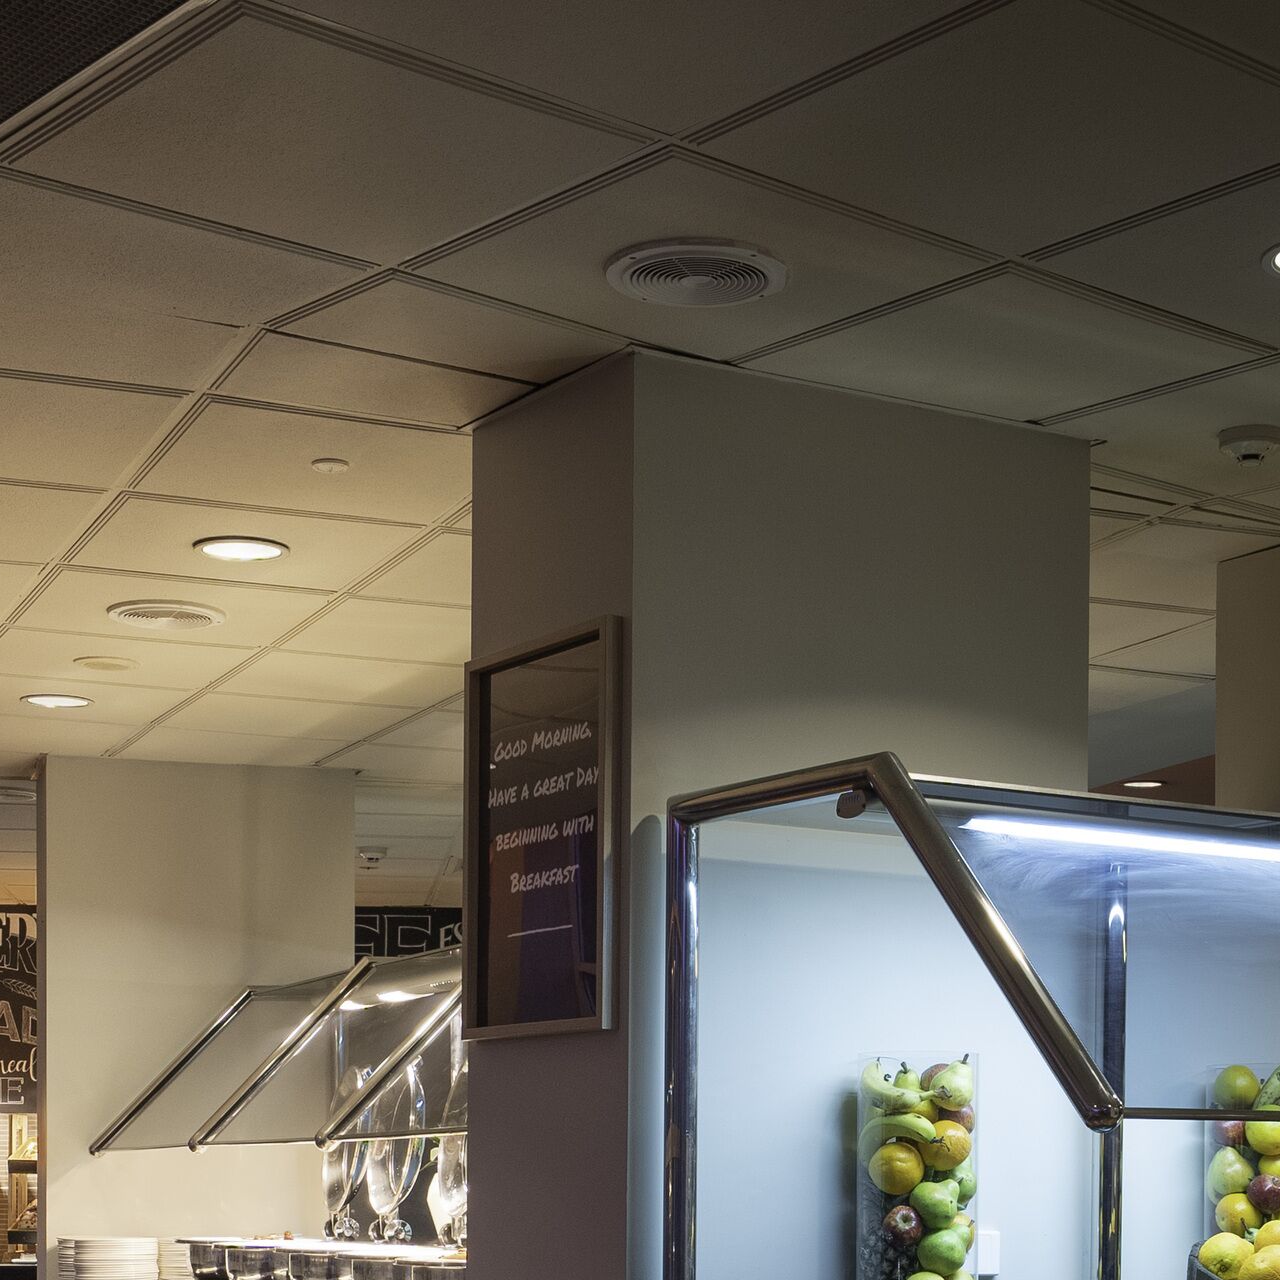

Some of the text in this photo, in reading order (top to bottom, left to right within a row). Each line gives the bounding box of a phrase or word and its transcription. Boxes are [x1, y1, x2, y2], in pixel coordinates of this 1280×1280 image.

[494, 739, 527, 762] GOOD
[488, 766, 599, 808] HAVE A GREAT DAY
[495, 814, 594, 852] BEGINNING WITH
[510, 864, 579, 893] BREAKFAST
